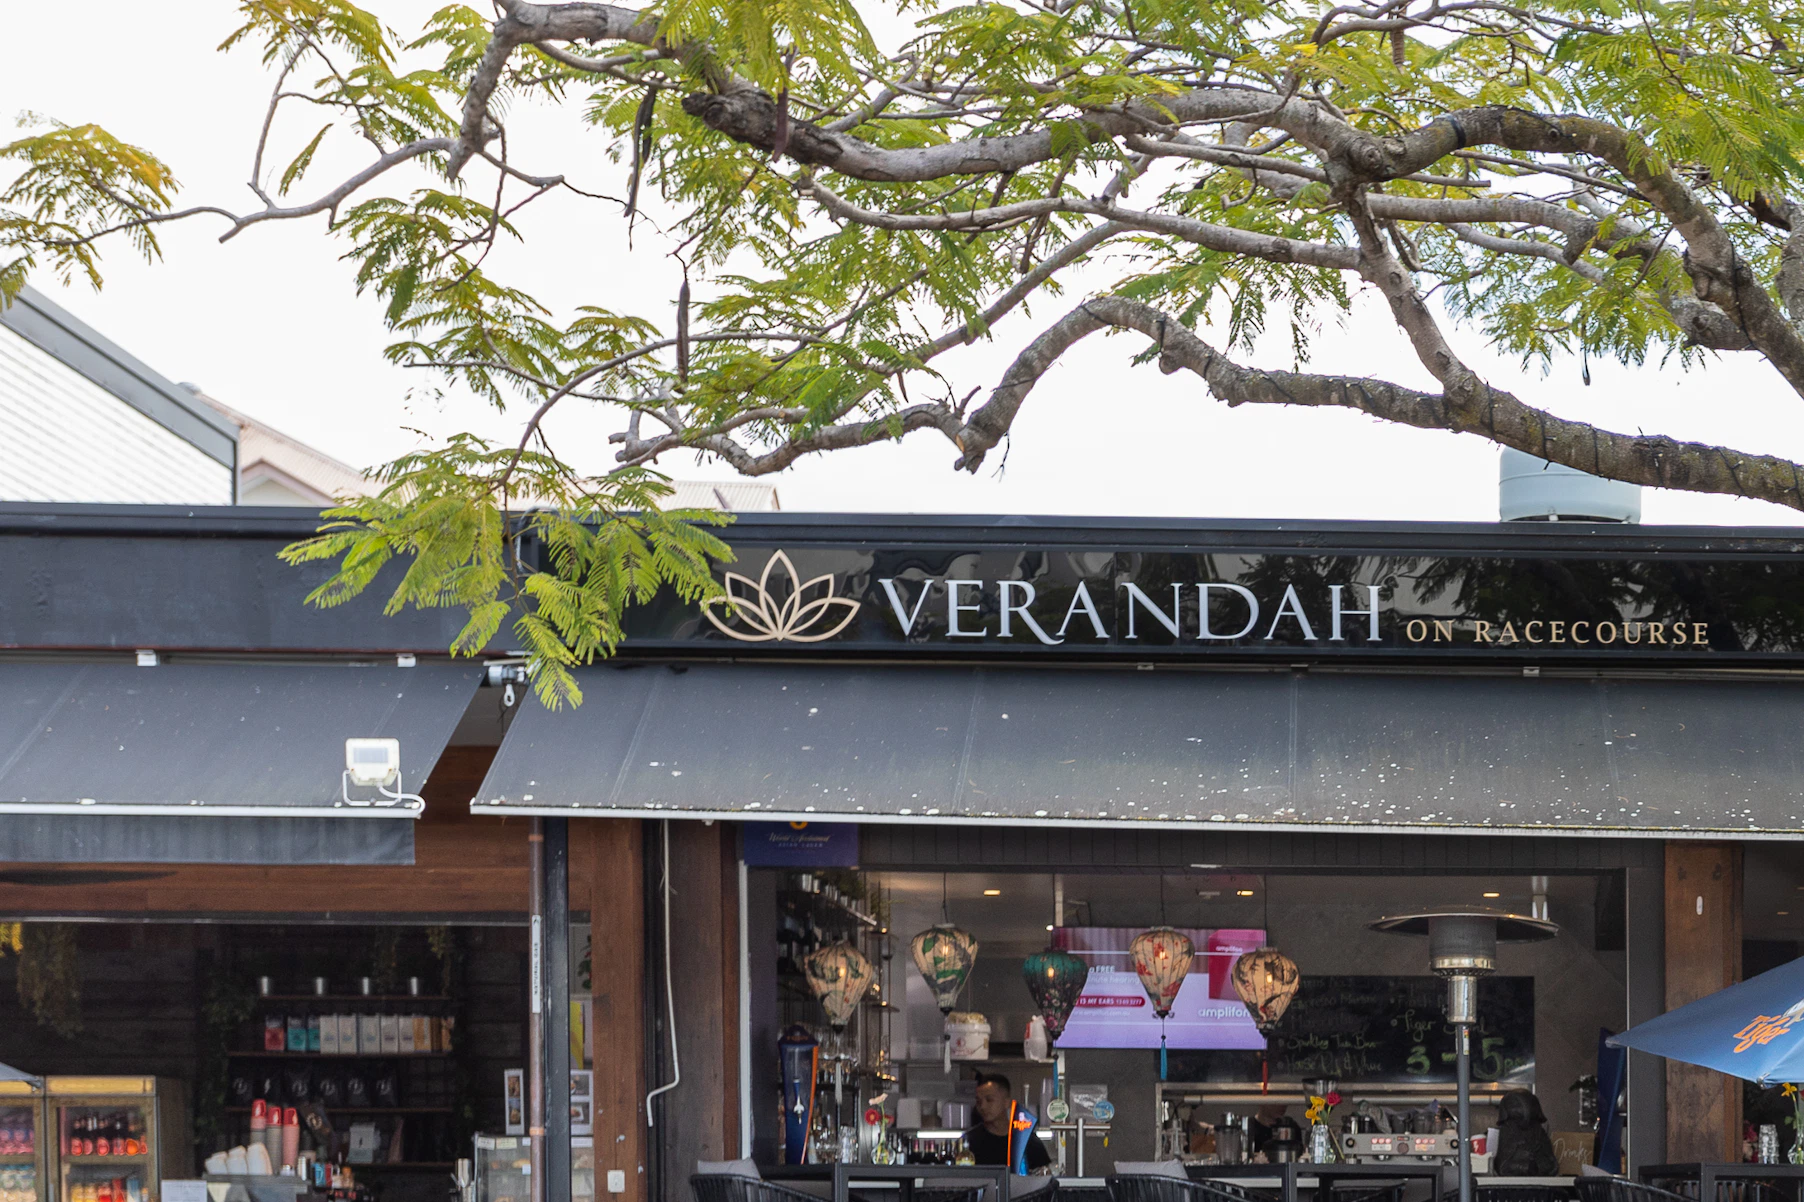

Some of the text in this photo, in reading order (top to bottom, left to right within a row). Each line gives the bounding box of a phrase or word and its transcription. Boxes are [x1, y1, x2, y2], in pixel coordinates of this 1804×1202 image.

[878, 578, 1709, 645] VERANDAH ON RACECOURSE
[1198, 1006, 1251, 1019] amplifon
[1733, 1014, 1790, 1054] Tiger
[1406, 1045, 1431, 1075] 3
